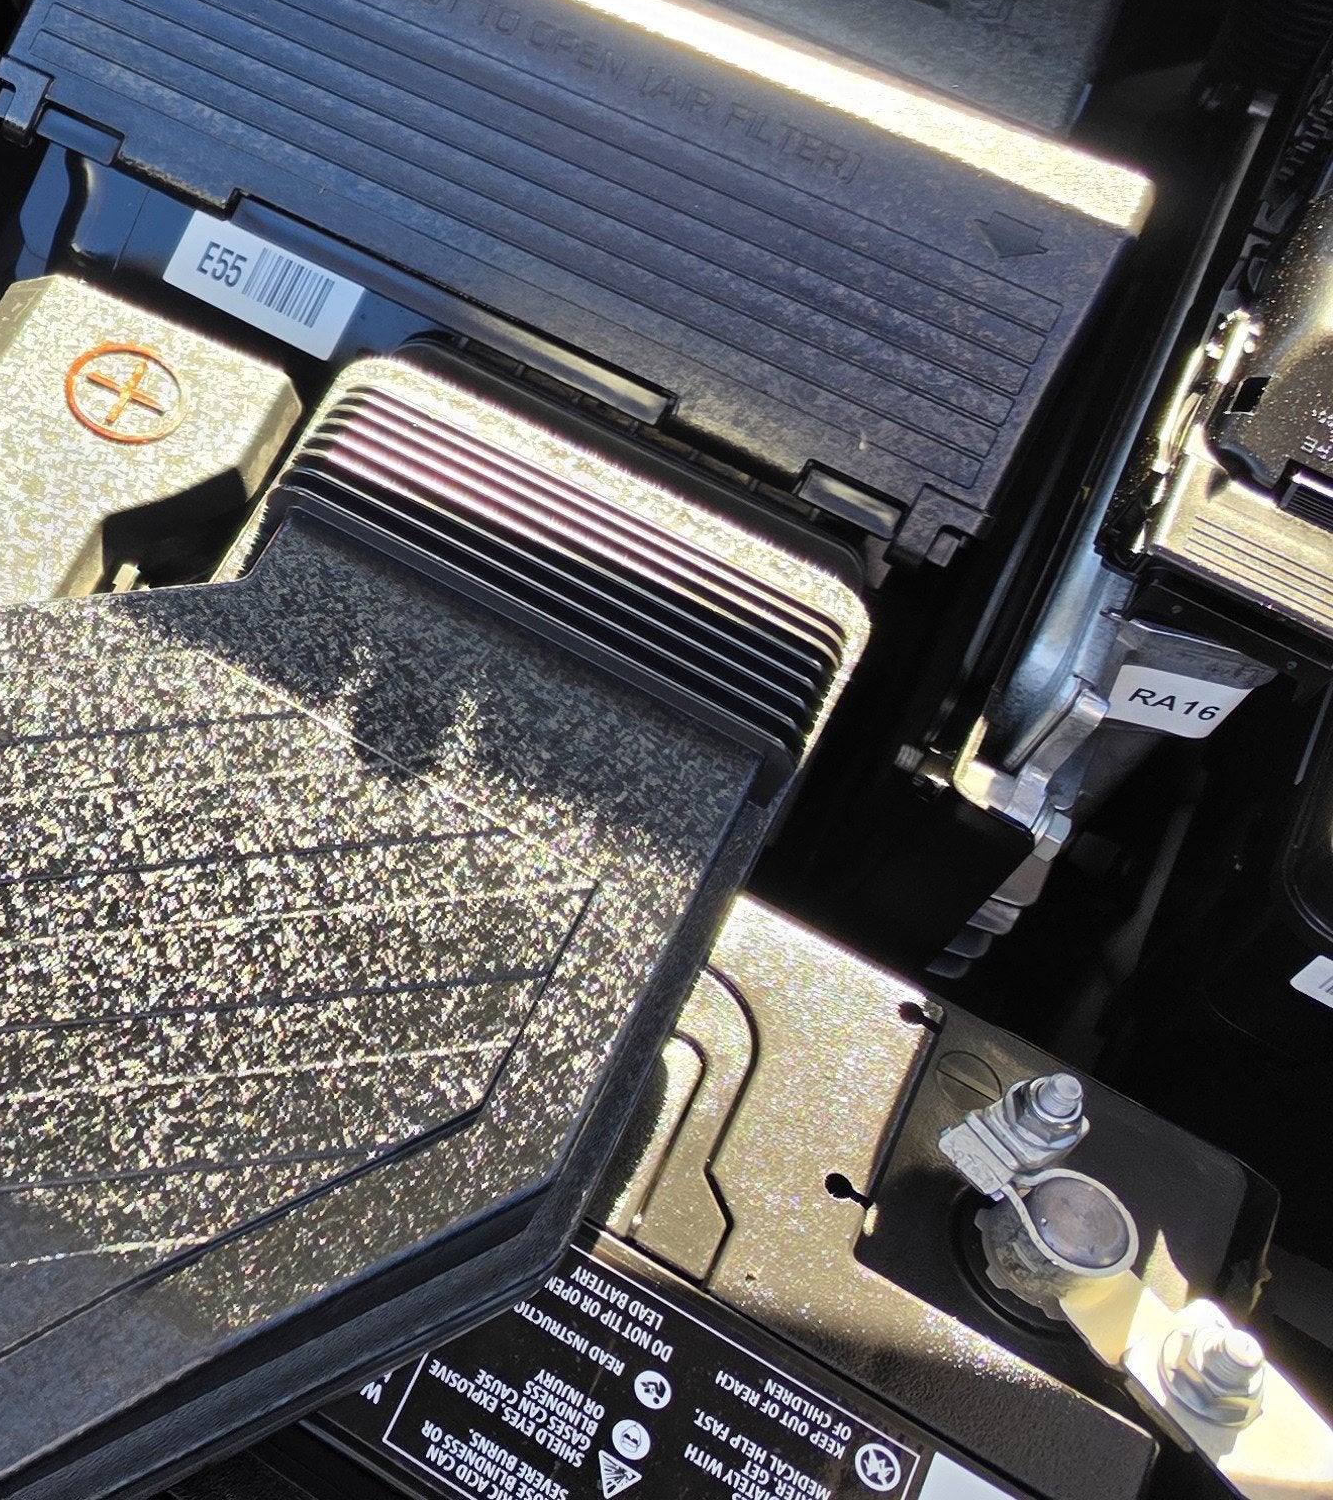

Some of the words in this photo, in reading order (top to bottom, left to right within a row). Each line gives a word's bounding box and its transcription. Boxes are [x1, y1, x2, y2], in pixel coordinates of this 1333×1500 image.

[527, 19, 627, 82] OPEN
[196, 240, 248, 288] E55
[1128, 688, 1221, 721] RA16
[544, 1276, 581, 1305] OPEN
[570, 1265, 629, 1309] BATTERY
[580, 1295, 601, 1317] OR
[600, 1309, 622, 1332] TIP
[628, 1300, 663, 1331] LEAD
[621, 1322, 652, 1349] NOT
[651, 1339, 673, 1362] DO
[588, 1346, 625, 1376] READ
[428, 1359, 498, 1412] EXPLOSIVE
[474, 1369, 518, 1404] CAUSE
[534, 1369, 584, 1407] INJURY
[715, 1370, 760, 1407] REACH
[518, 1396, 547, 1423] CAN
[522, 1380, 598, 1436] BLINDNESS
[583, 1397, 604, 1419] OR
[759, 1399, 780, 1418] OF
[764, 1378, 831, 1428] CHILDREN
[421, 1420, 442, 1442] OR
[501, 1403, 535, 1437] EYES.
[546, 1415, 591, 1451] GASES
[693, 1408, 730, 1441] FAST.
[779, 1411, 809, 1436] OUT
[831, 1422, 851, 1440] OF
[425, 1444, 455, 1471] CAN
[463, 1428, 518, 1471] BURNS.
[535, 1428, 585, 1467] SHIELD
[684, 1443, 723, 1478] WITH
[729, 1434, 767, 1464] HELP
[809, 1430, 845, 1460] KEEP
[441, 1434, 521, 1492] BLINDNESS
[455, 1464, 489, 1492] ACID
[740, 1460, 769, 1485] GET
[770, 1454, 831, 1500] MEDICAL
[516, 1461, 569, 1500] SEVERE
